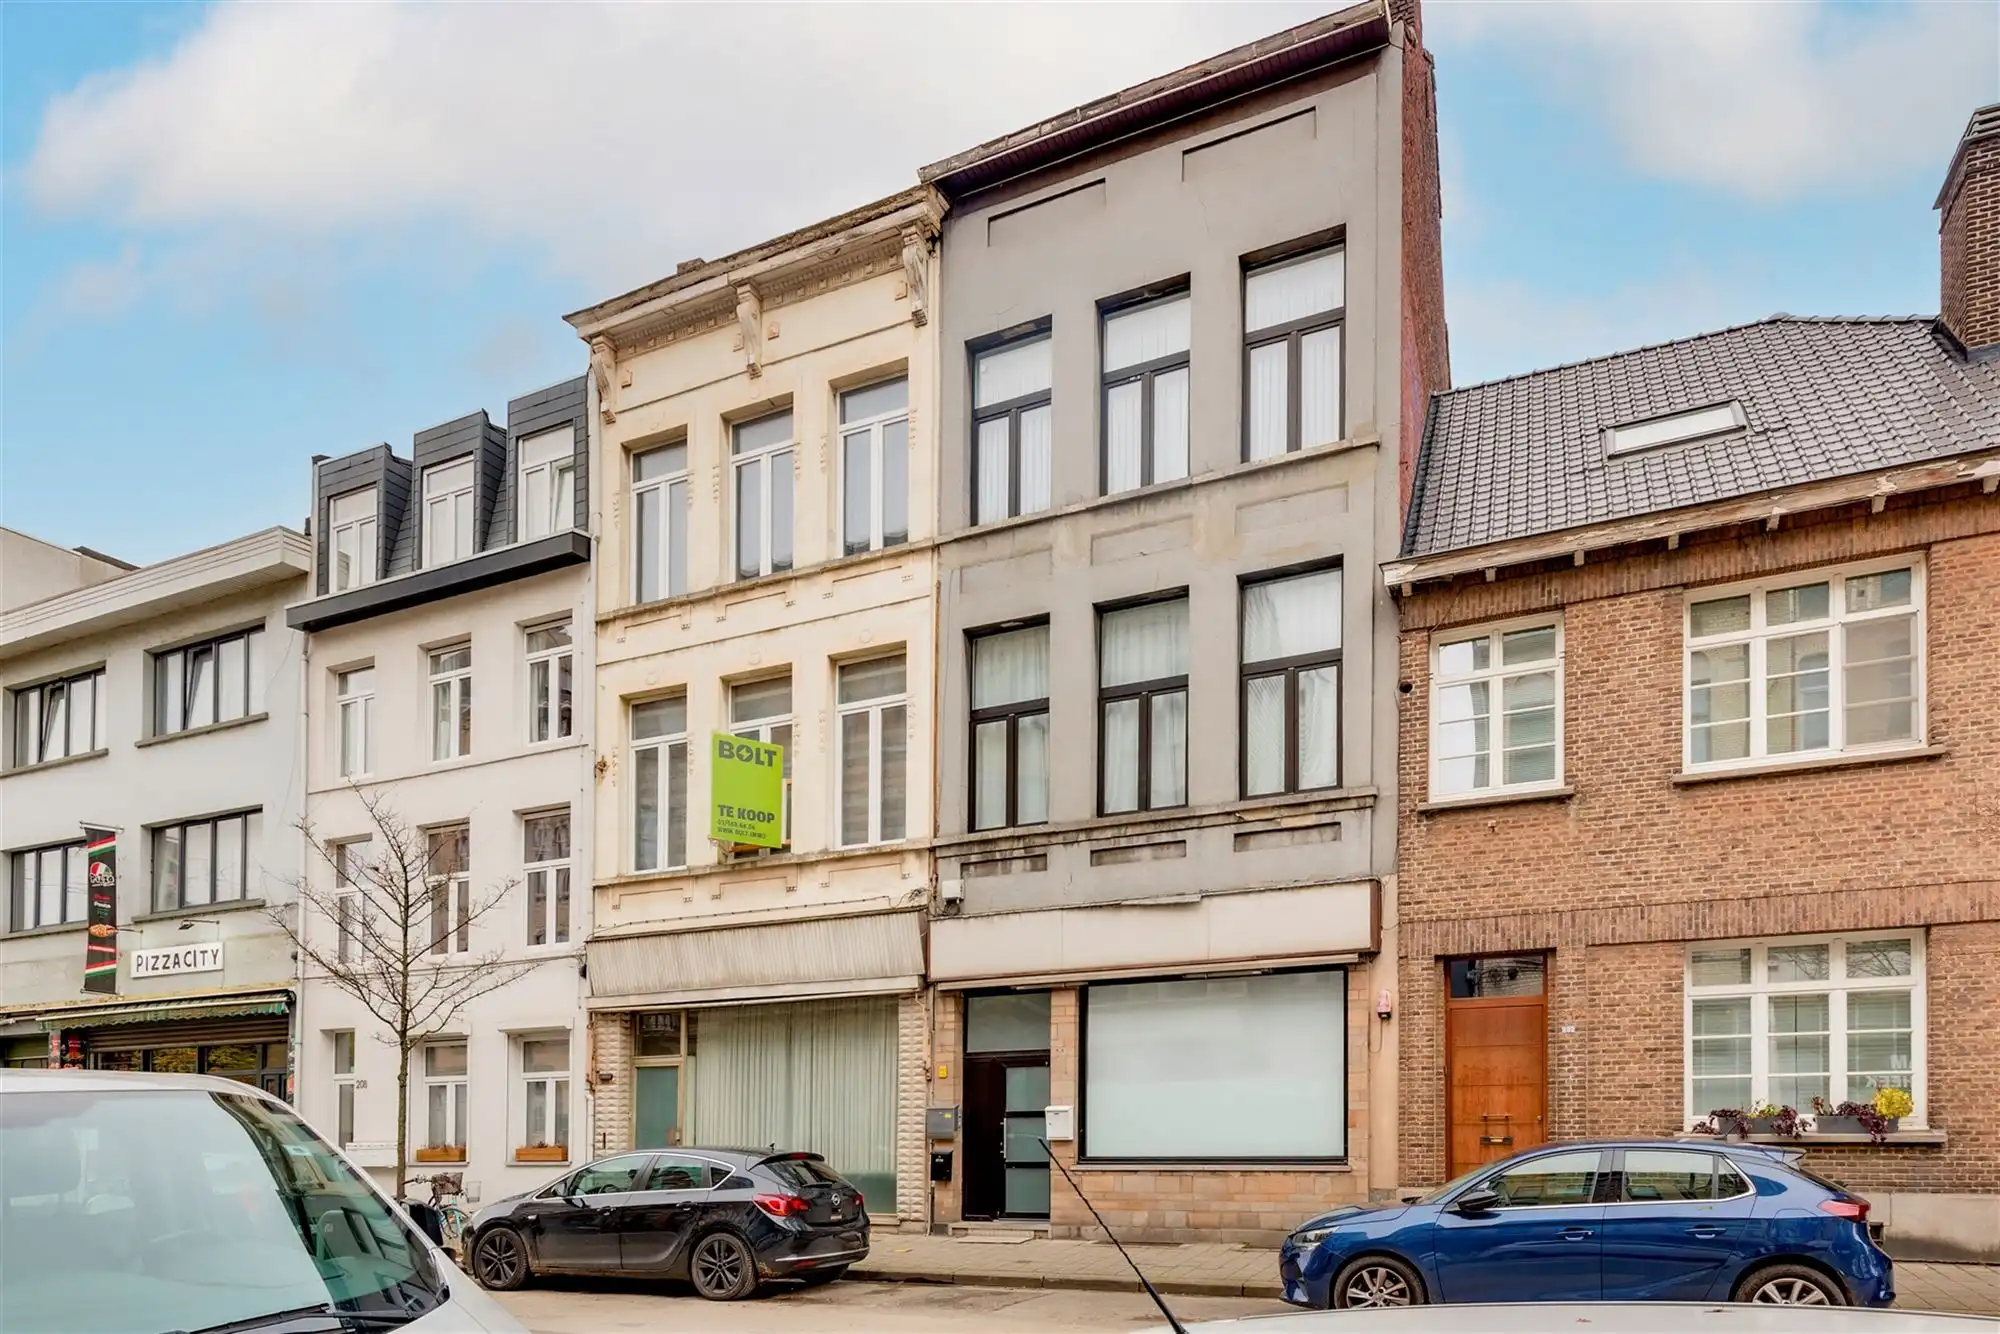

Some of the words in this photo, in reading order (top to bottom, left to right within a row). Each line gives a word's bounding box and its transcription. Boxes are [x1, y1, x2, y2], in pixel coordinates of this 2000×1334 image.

[718, 740, 777, 767] BOLT
[717, 804, 734, 818] TE
[737, 807, 775, 824] KOOP
